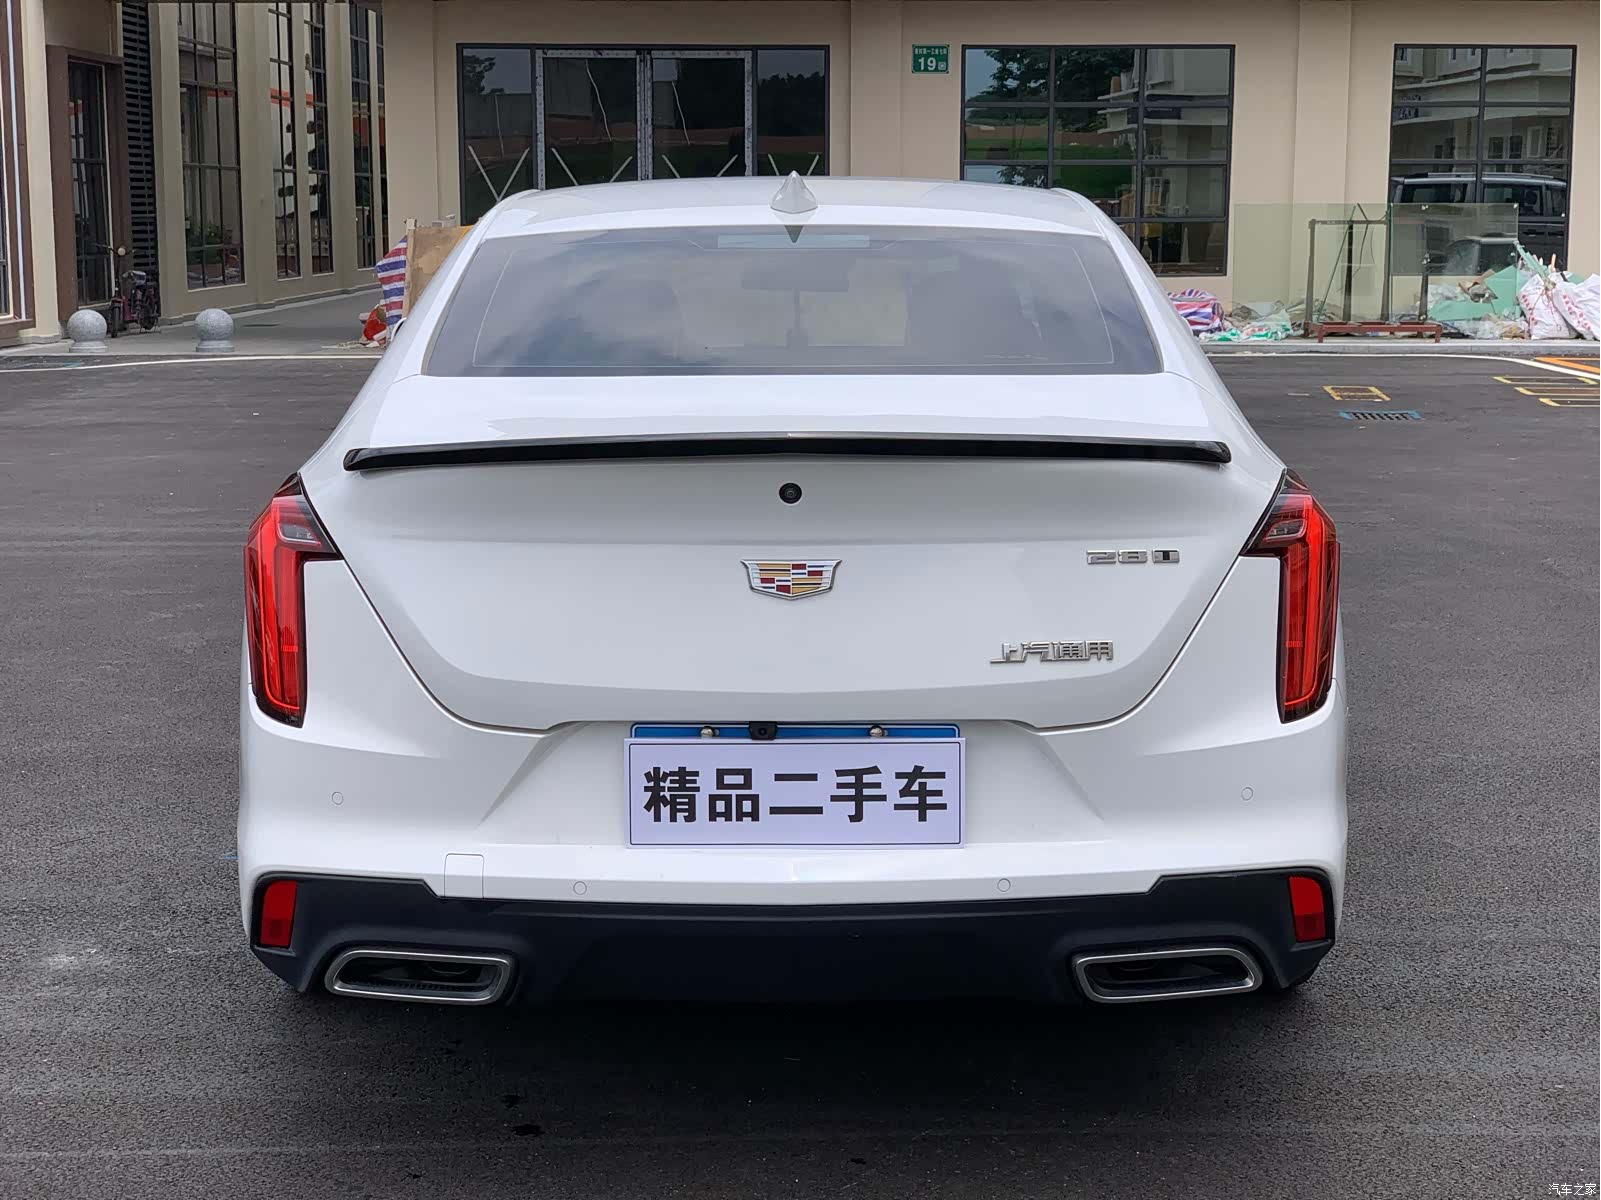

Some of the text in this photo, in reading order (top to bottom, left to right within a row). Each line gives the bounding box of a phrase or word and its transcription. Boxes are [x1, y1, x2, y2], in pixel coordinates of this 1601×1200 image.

[918, 57, 937, 71] 19
[990, 640, 1113, 664] 上汽通用
[643, 765, 948, 823] 精品二手车
